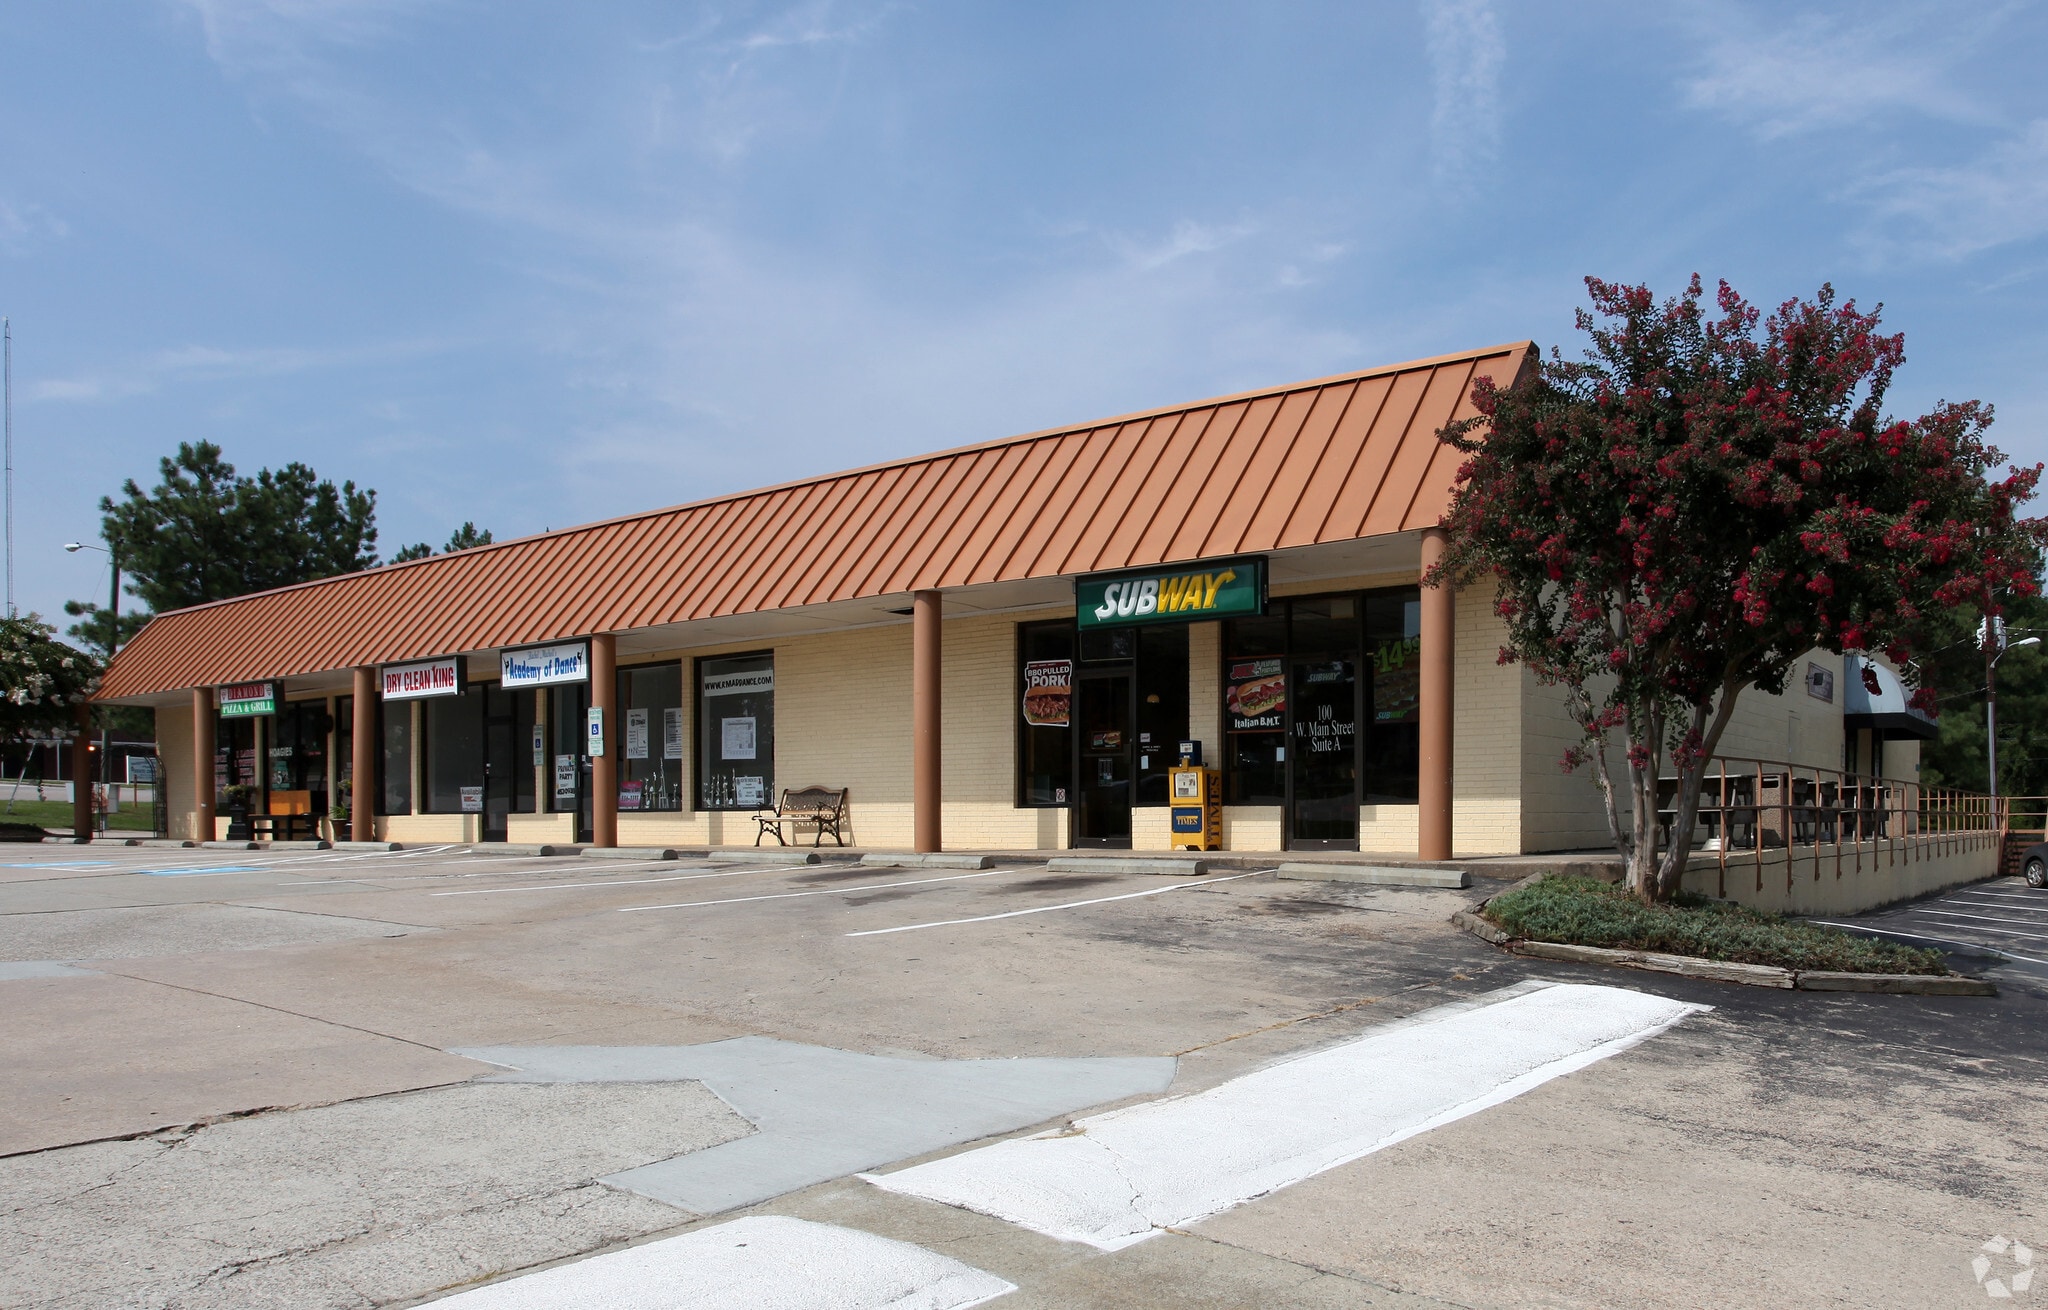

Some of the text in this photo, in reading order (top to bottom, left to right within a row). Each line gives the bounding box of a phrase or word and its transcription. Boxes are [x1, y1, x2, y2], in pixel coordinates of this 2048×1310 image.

[1095, 569, 1236, 621] SUBWAY
[509, 656, 577, 681] Academy of Dance
[1027, 666, 1069, 677] BBQ PULLED
[1307, 671, 1340, 682] SUBWAY
[386, 666, 454, 694] DRY CLEAN KING
[1031, 675, 1066, 687] PORK
[228, 686, 264, 699] DIAMOND
[223, 700, 272, 713] PIZZA & GRILL
[1318, 704, 1332, 721] 100
[1234, 718, 1259, 728] Italian
[1296, 720, 1355, 737] W. Main Street
[1312, 736, 1341, 752] Suite A
[1210, 776, 1220, 840] TIMES
